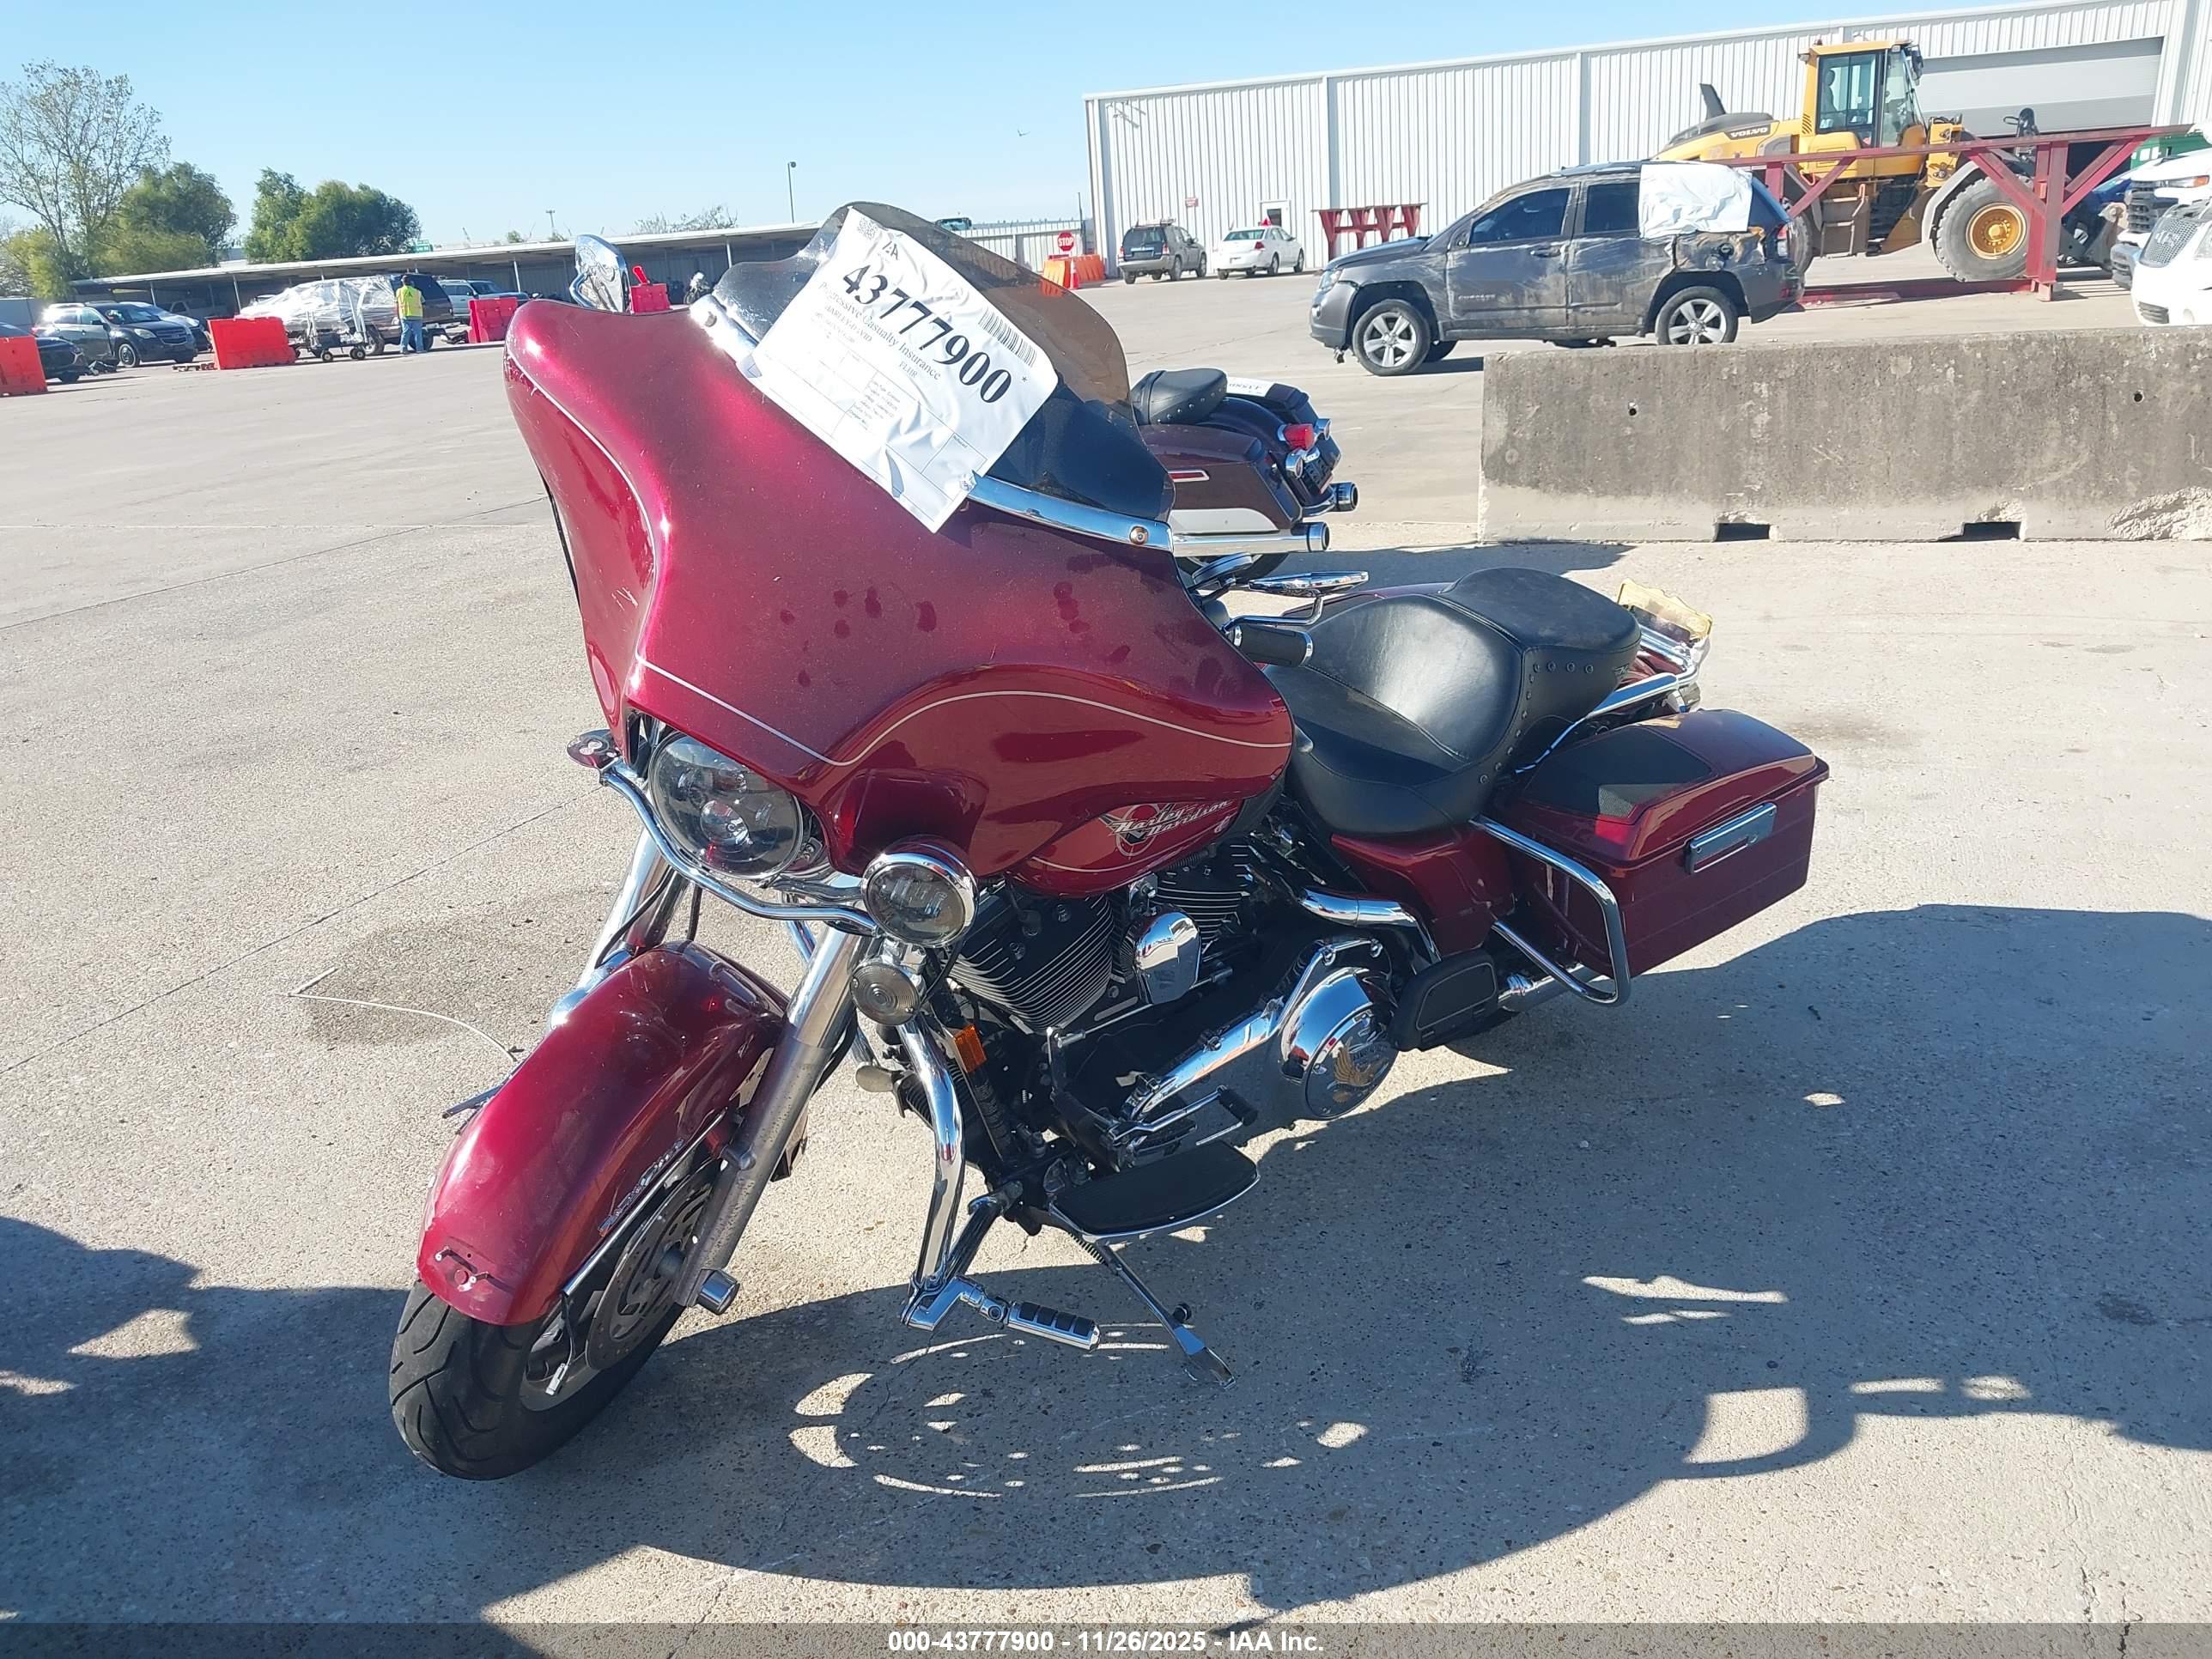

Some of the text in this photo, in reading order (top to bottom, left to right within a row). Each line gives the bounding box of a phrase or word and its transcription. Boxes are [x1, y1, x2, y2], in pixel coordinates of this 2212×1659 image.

[1730, 127, 1768, 138] VOLVO
[1058, 237, 1074, 246] STOP
[818, 281, 863, 318] Progressive
[863, 314, 900, 347] Casualty
[898, 343, 941, 380] Insurance
[842, 264, 1012, 404] 43777900
[1112, 808, 1185, 834] Harley
[1144, 799, 1230, 837] Davidson
